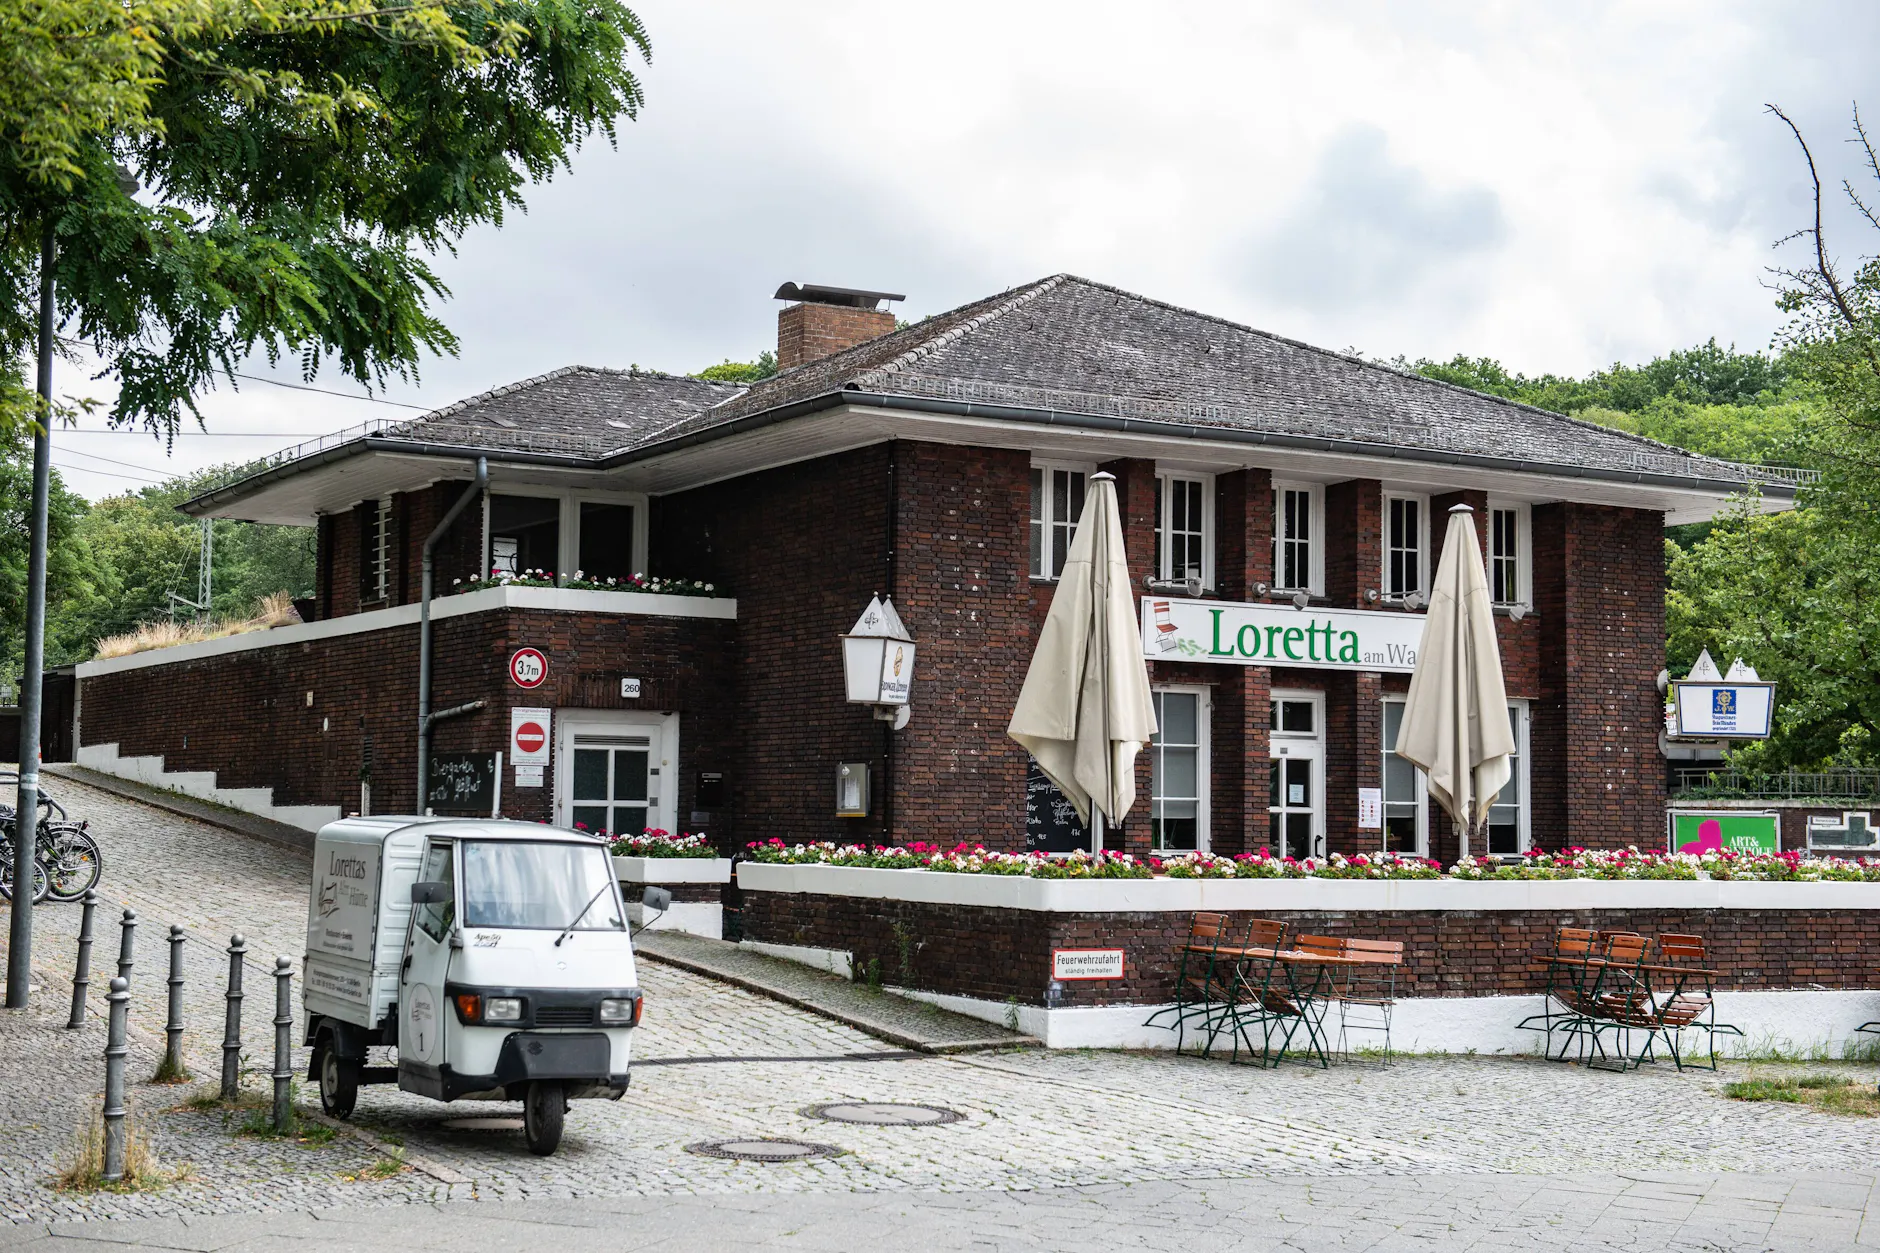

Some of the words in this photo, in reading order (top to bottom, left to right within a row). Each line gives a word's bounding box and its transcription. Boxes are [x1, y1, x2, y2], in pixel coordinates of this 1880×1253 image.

[1208, 609, 1361, 664] Loretta
[1364, 651, 1385, 664] am
[624, 684, 640, 693] 260
[1730, 836, 1759, 847] ART&
[329, 850, 366, 880] Lorettas
[1057, 954, 1120, 964] Feuerwehrzufahrt
[419, 1032, 425, 1052] 1
